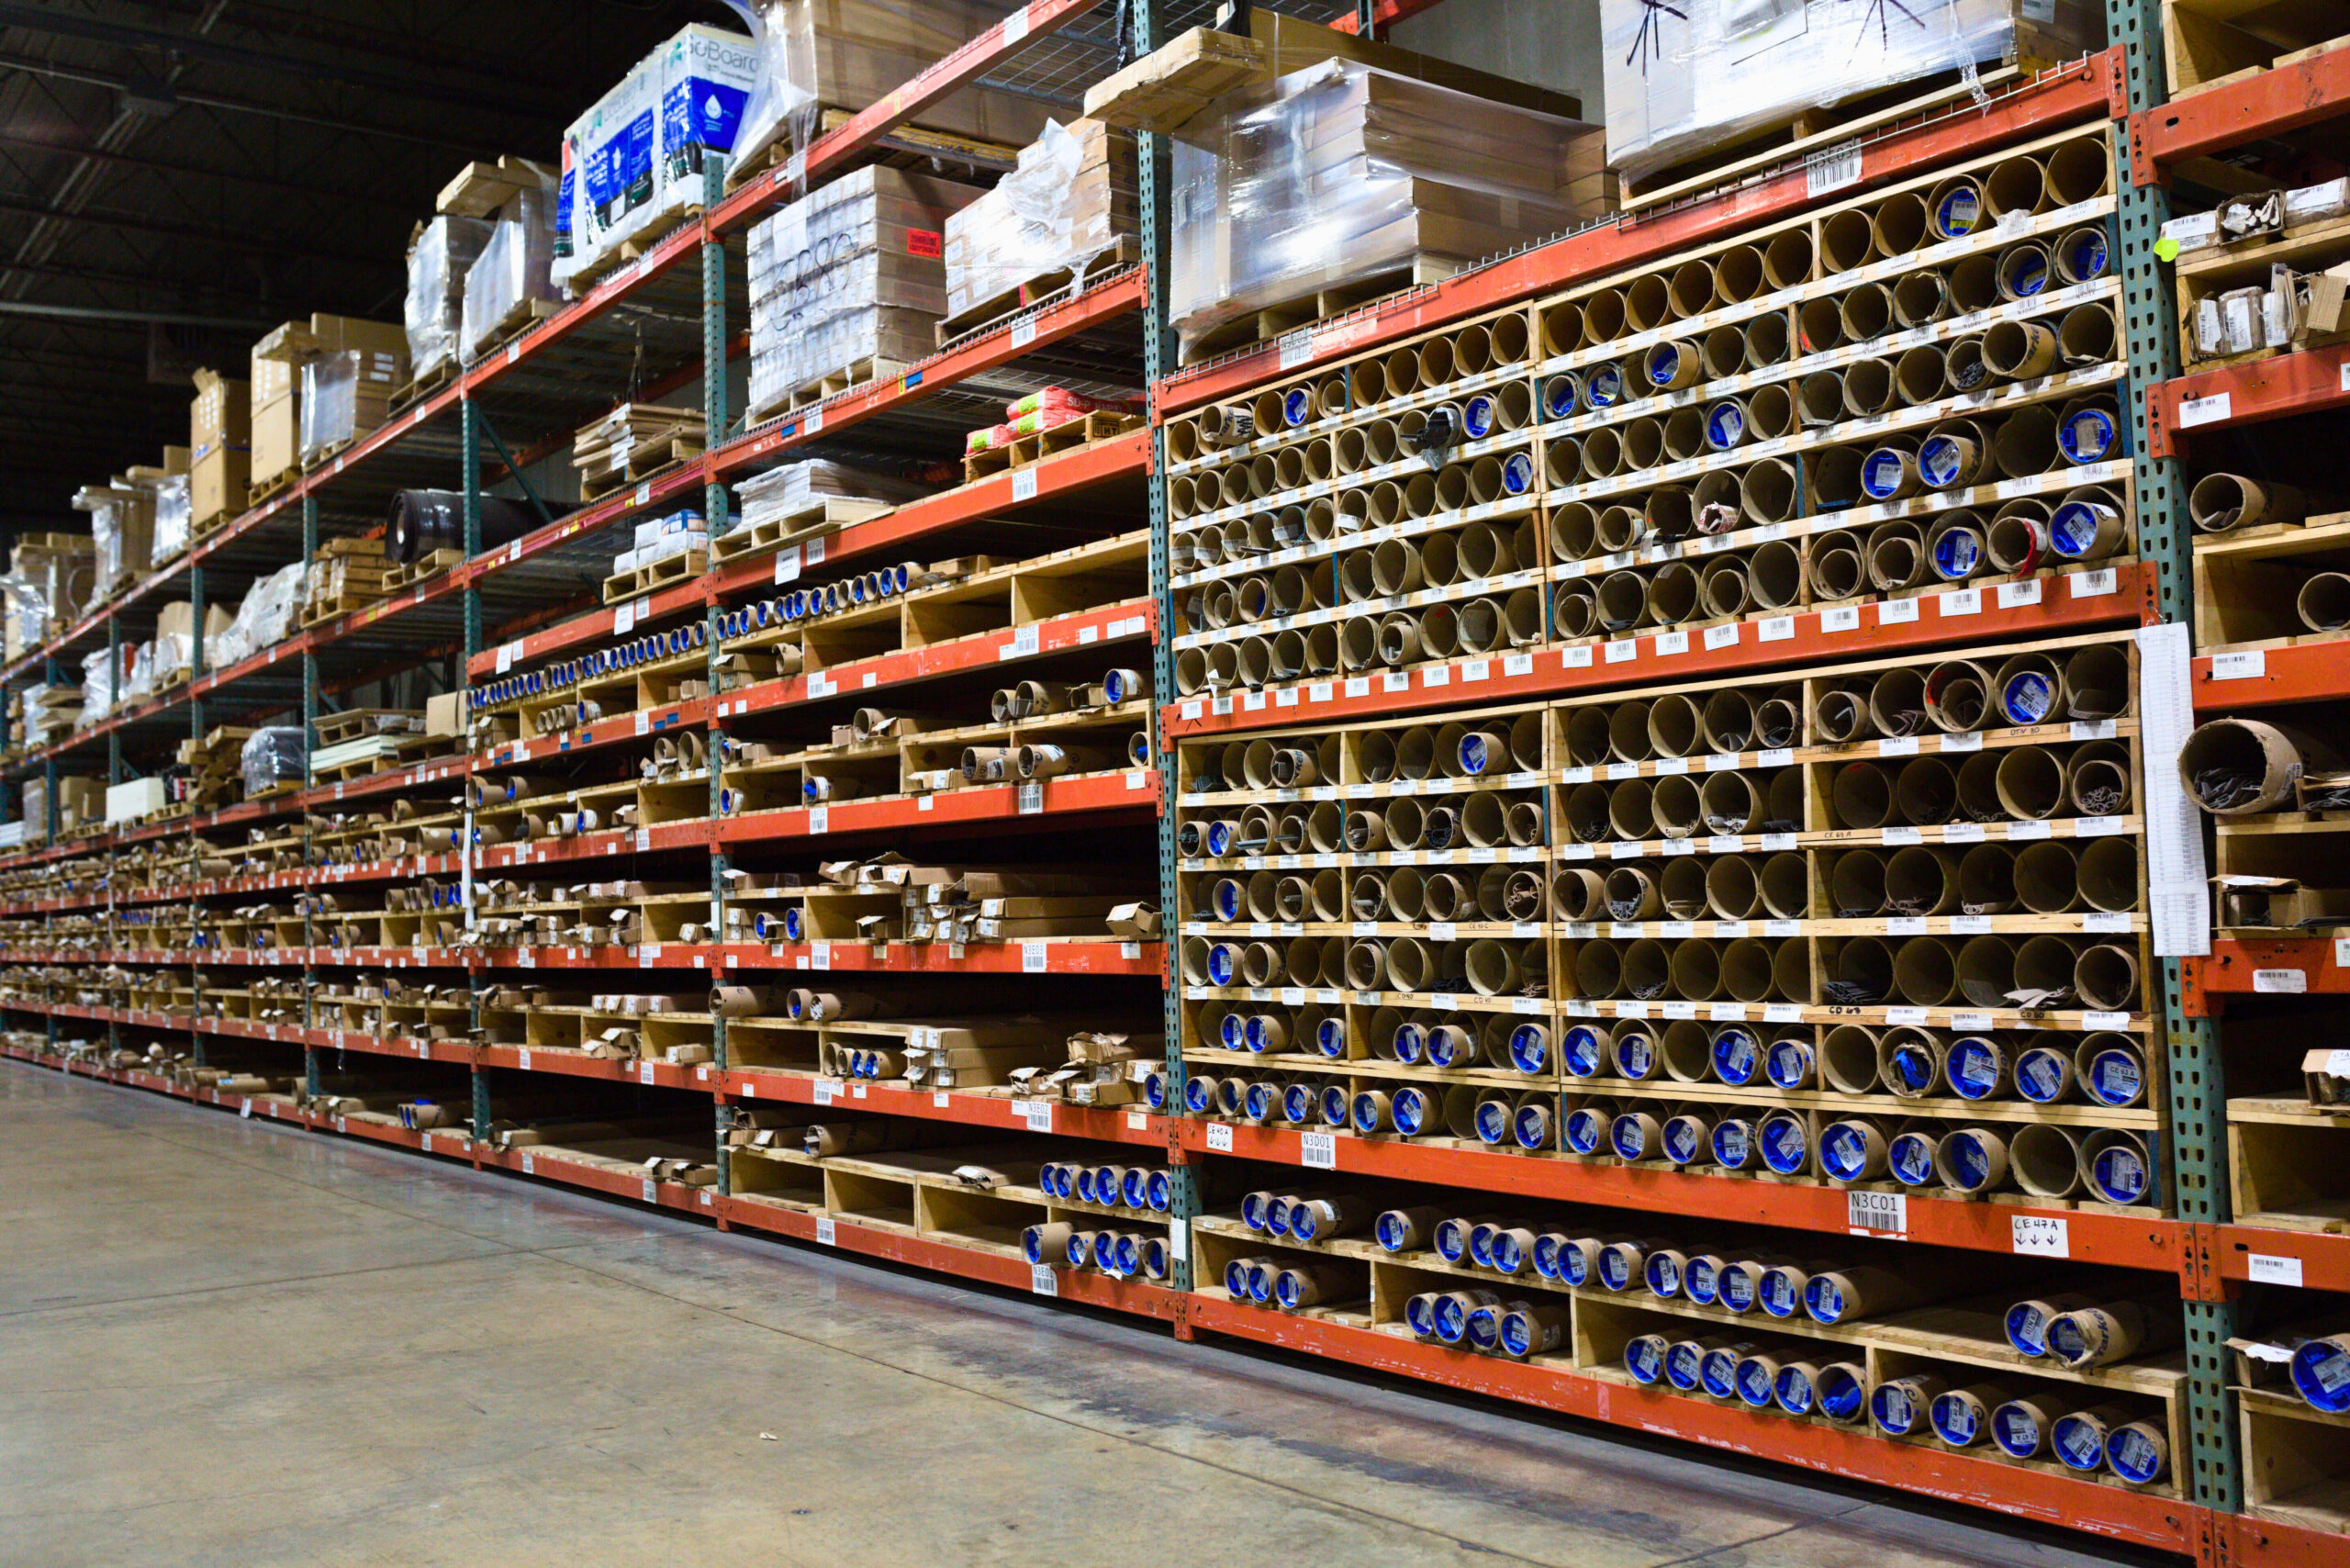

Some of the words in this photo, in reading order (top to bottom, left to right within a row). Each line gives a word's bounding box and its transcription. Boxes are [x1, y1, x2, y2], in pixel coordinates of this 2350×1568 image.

[1019, 783, 1040, 796] N3E04
[1024, 944, 1044, 955] N3E03
[1829, 1006, 1843, 1014] CD
[1028, 1102, 1049, 1114] N3E02
[1303, 1135, 1331, 1149] N3D01
[1852, 1193, 1898, 1213] N3C01
[2014, 1218, 2031, 1231] CE
[2050, 1220, 2058, 1231] A
